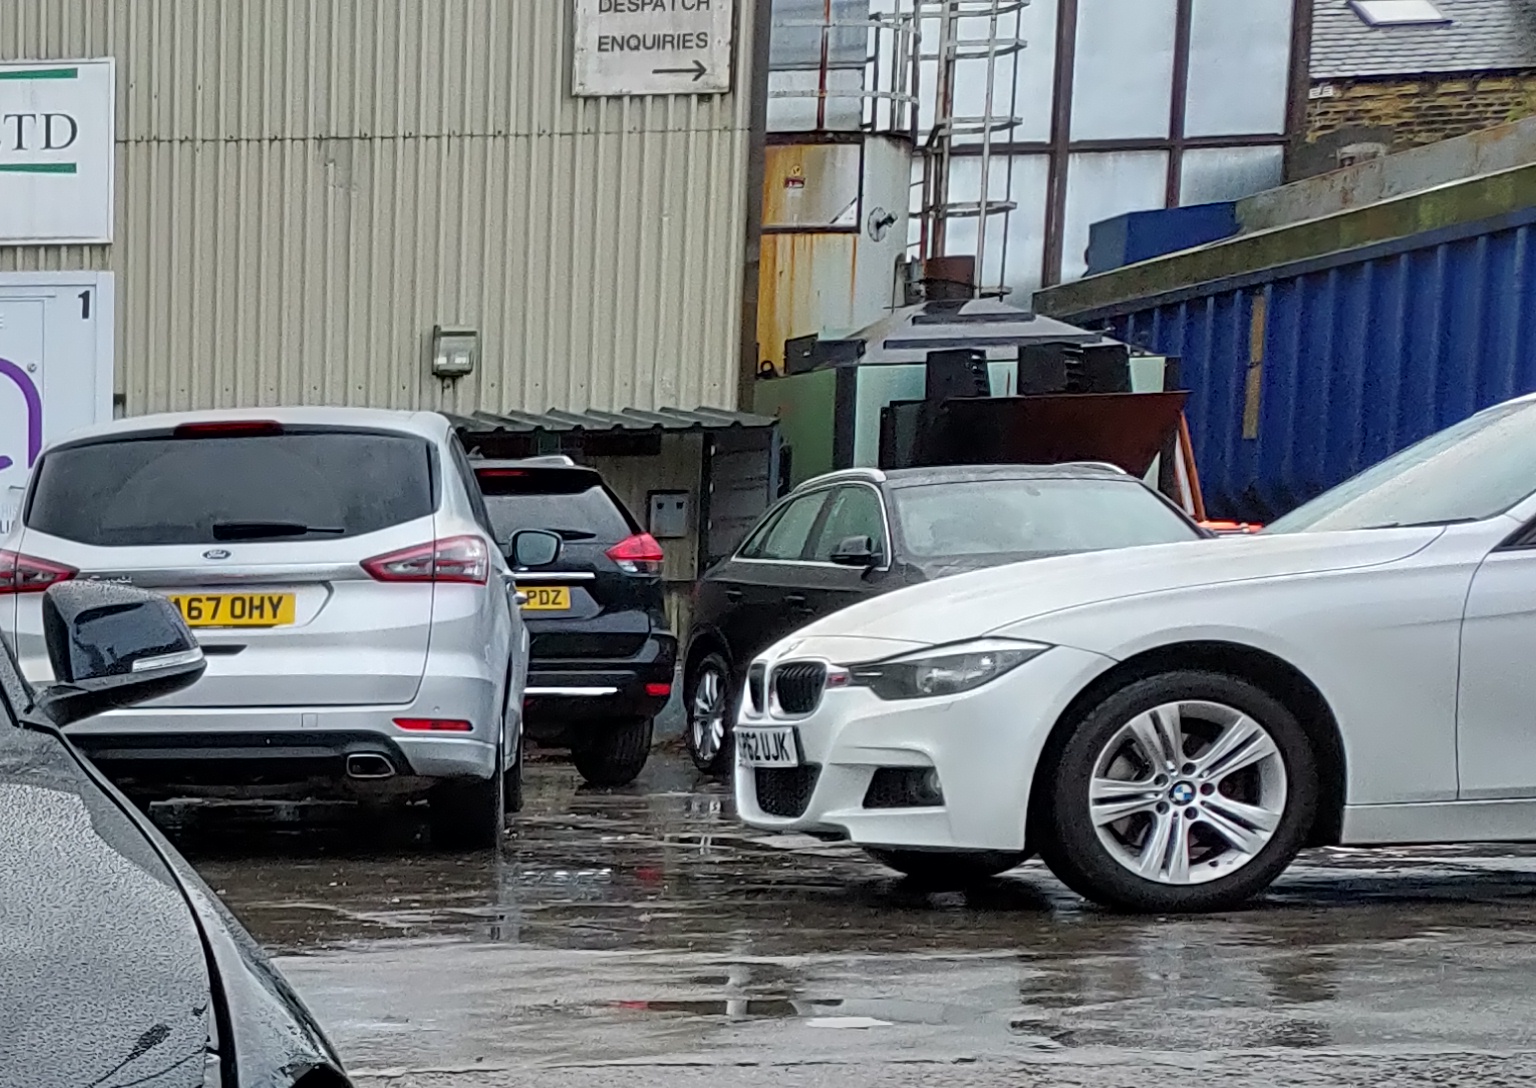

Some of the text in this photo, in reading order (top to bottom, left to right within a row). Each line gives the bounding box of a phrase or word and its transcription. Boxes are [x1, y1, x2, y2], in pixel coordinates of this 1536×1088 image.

[599, 0, 710, 13] DESPATCH
[597, 32, 708, 52] ENQUIRIES
[78, 290, 90, 320] 1
[230, 596, 284, 620] OHY
[760, 732, 790, 761] UJK
